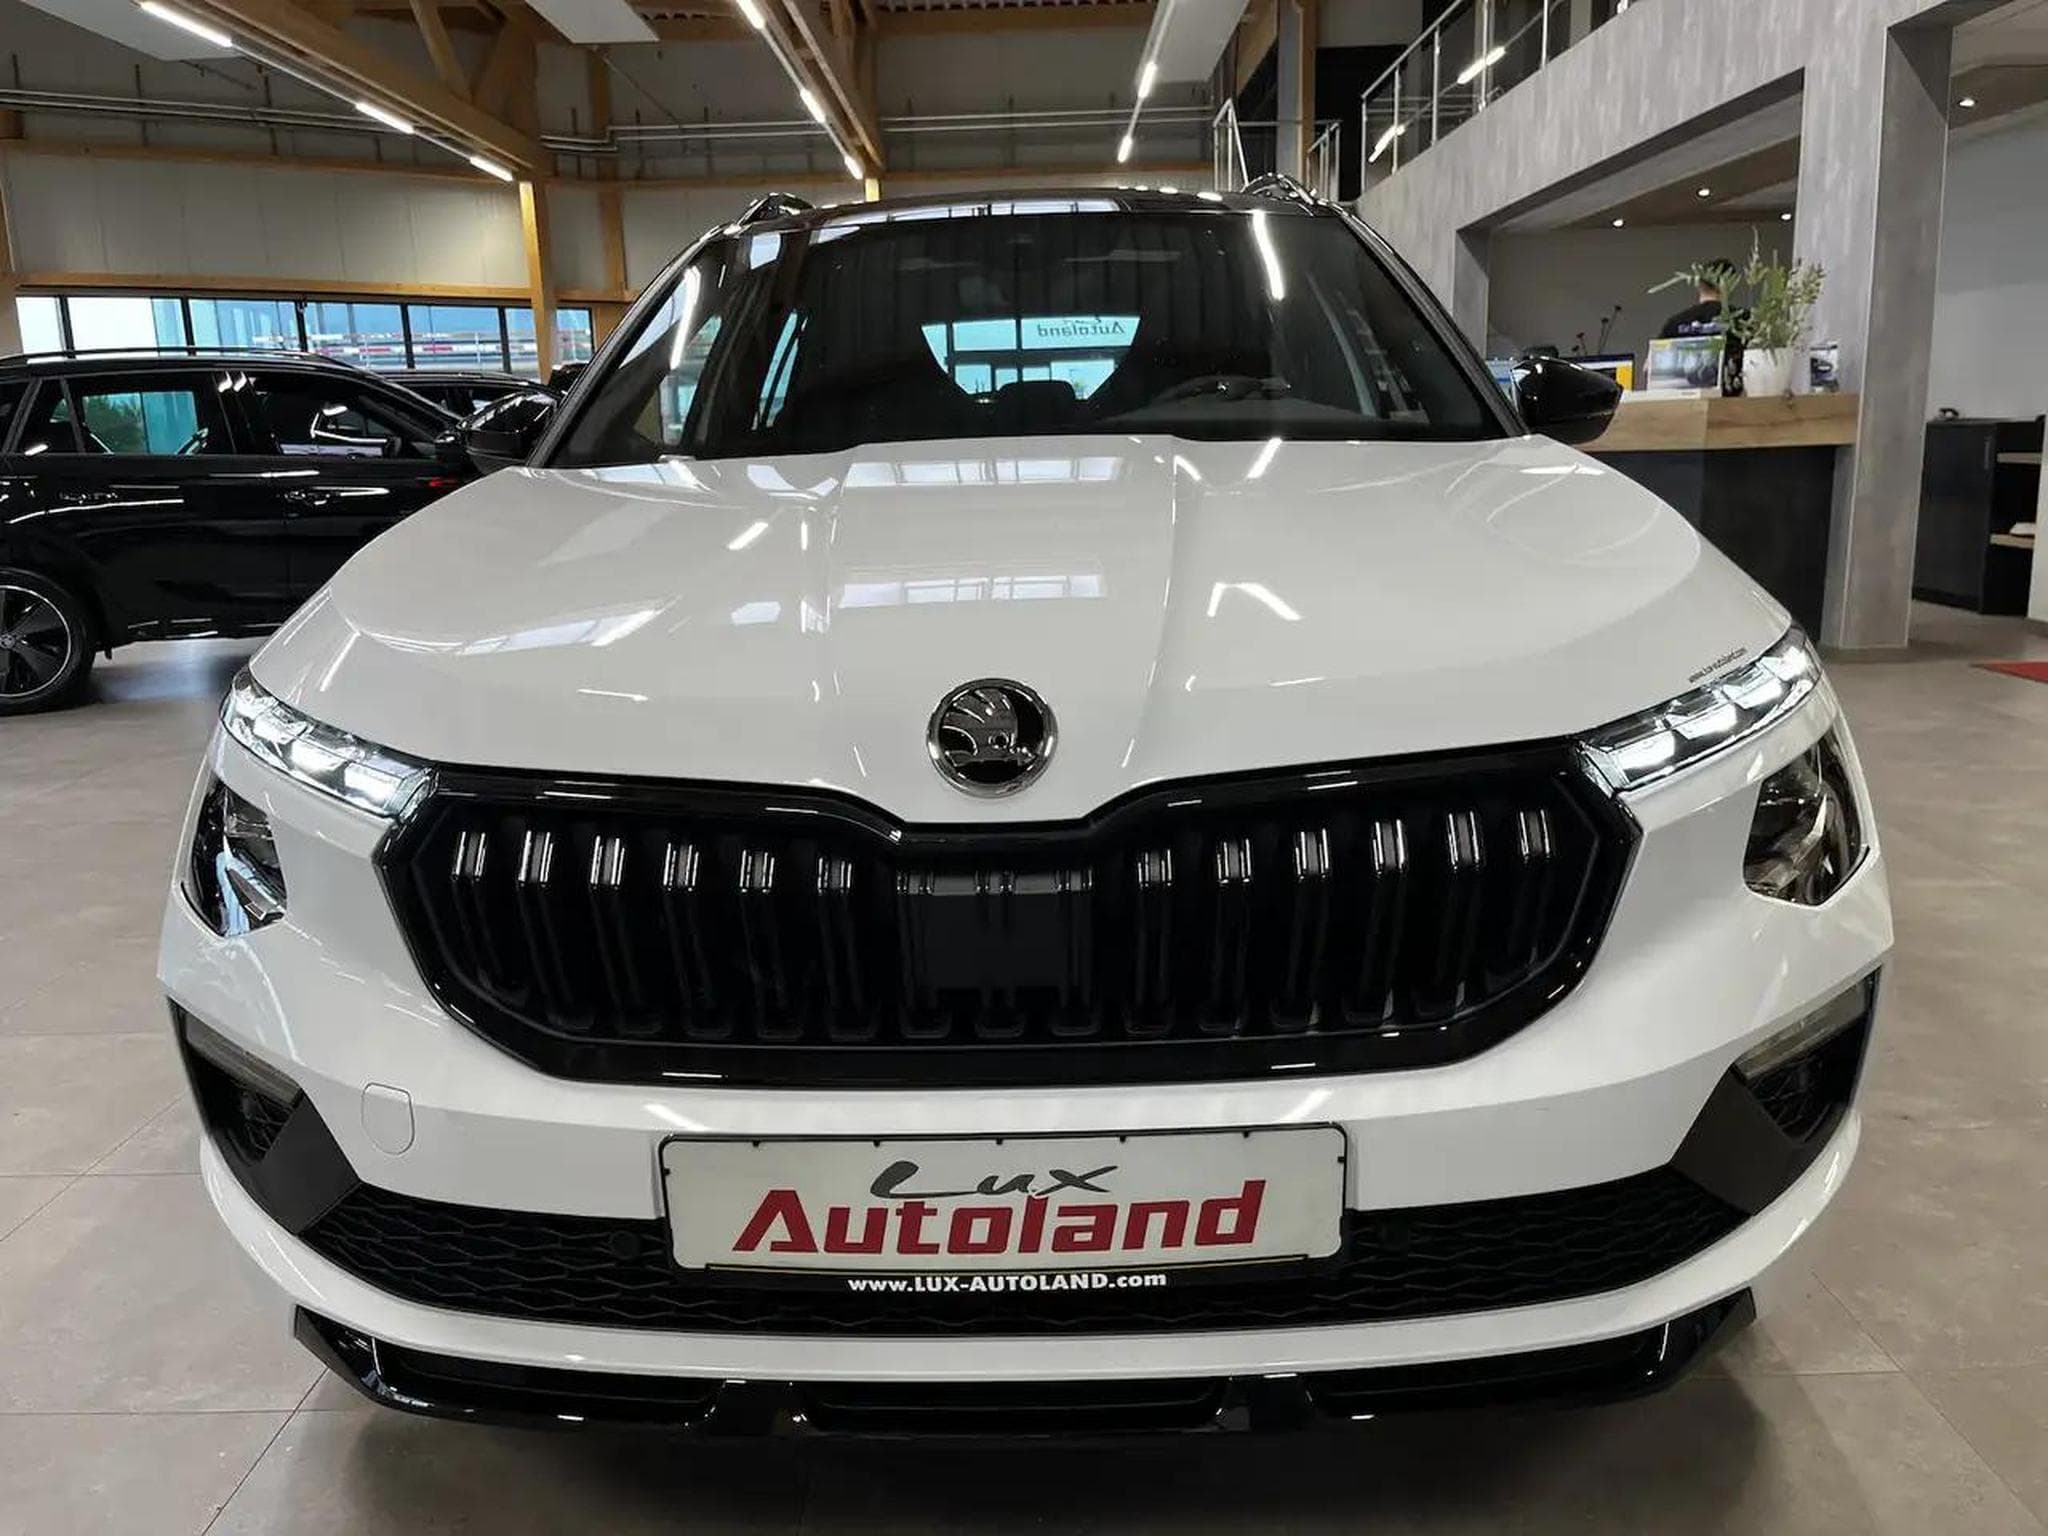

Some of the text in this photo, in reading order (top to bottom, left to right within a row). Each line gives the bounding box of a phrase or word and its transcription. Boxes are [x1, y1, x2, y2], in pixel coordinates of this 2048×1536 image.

[870, 1160, 1119, 1199] Lux
[731, 1179, 1266, 1255] Autoland
[847, 1273, 1167, 1292] www.LUX-AUTOLAND.com
